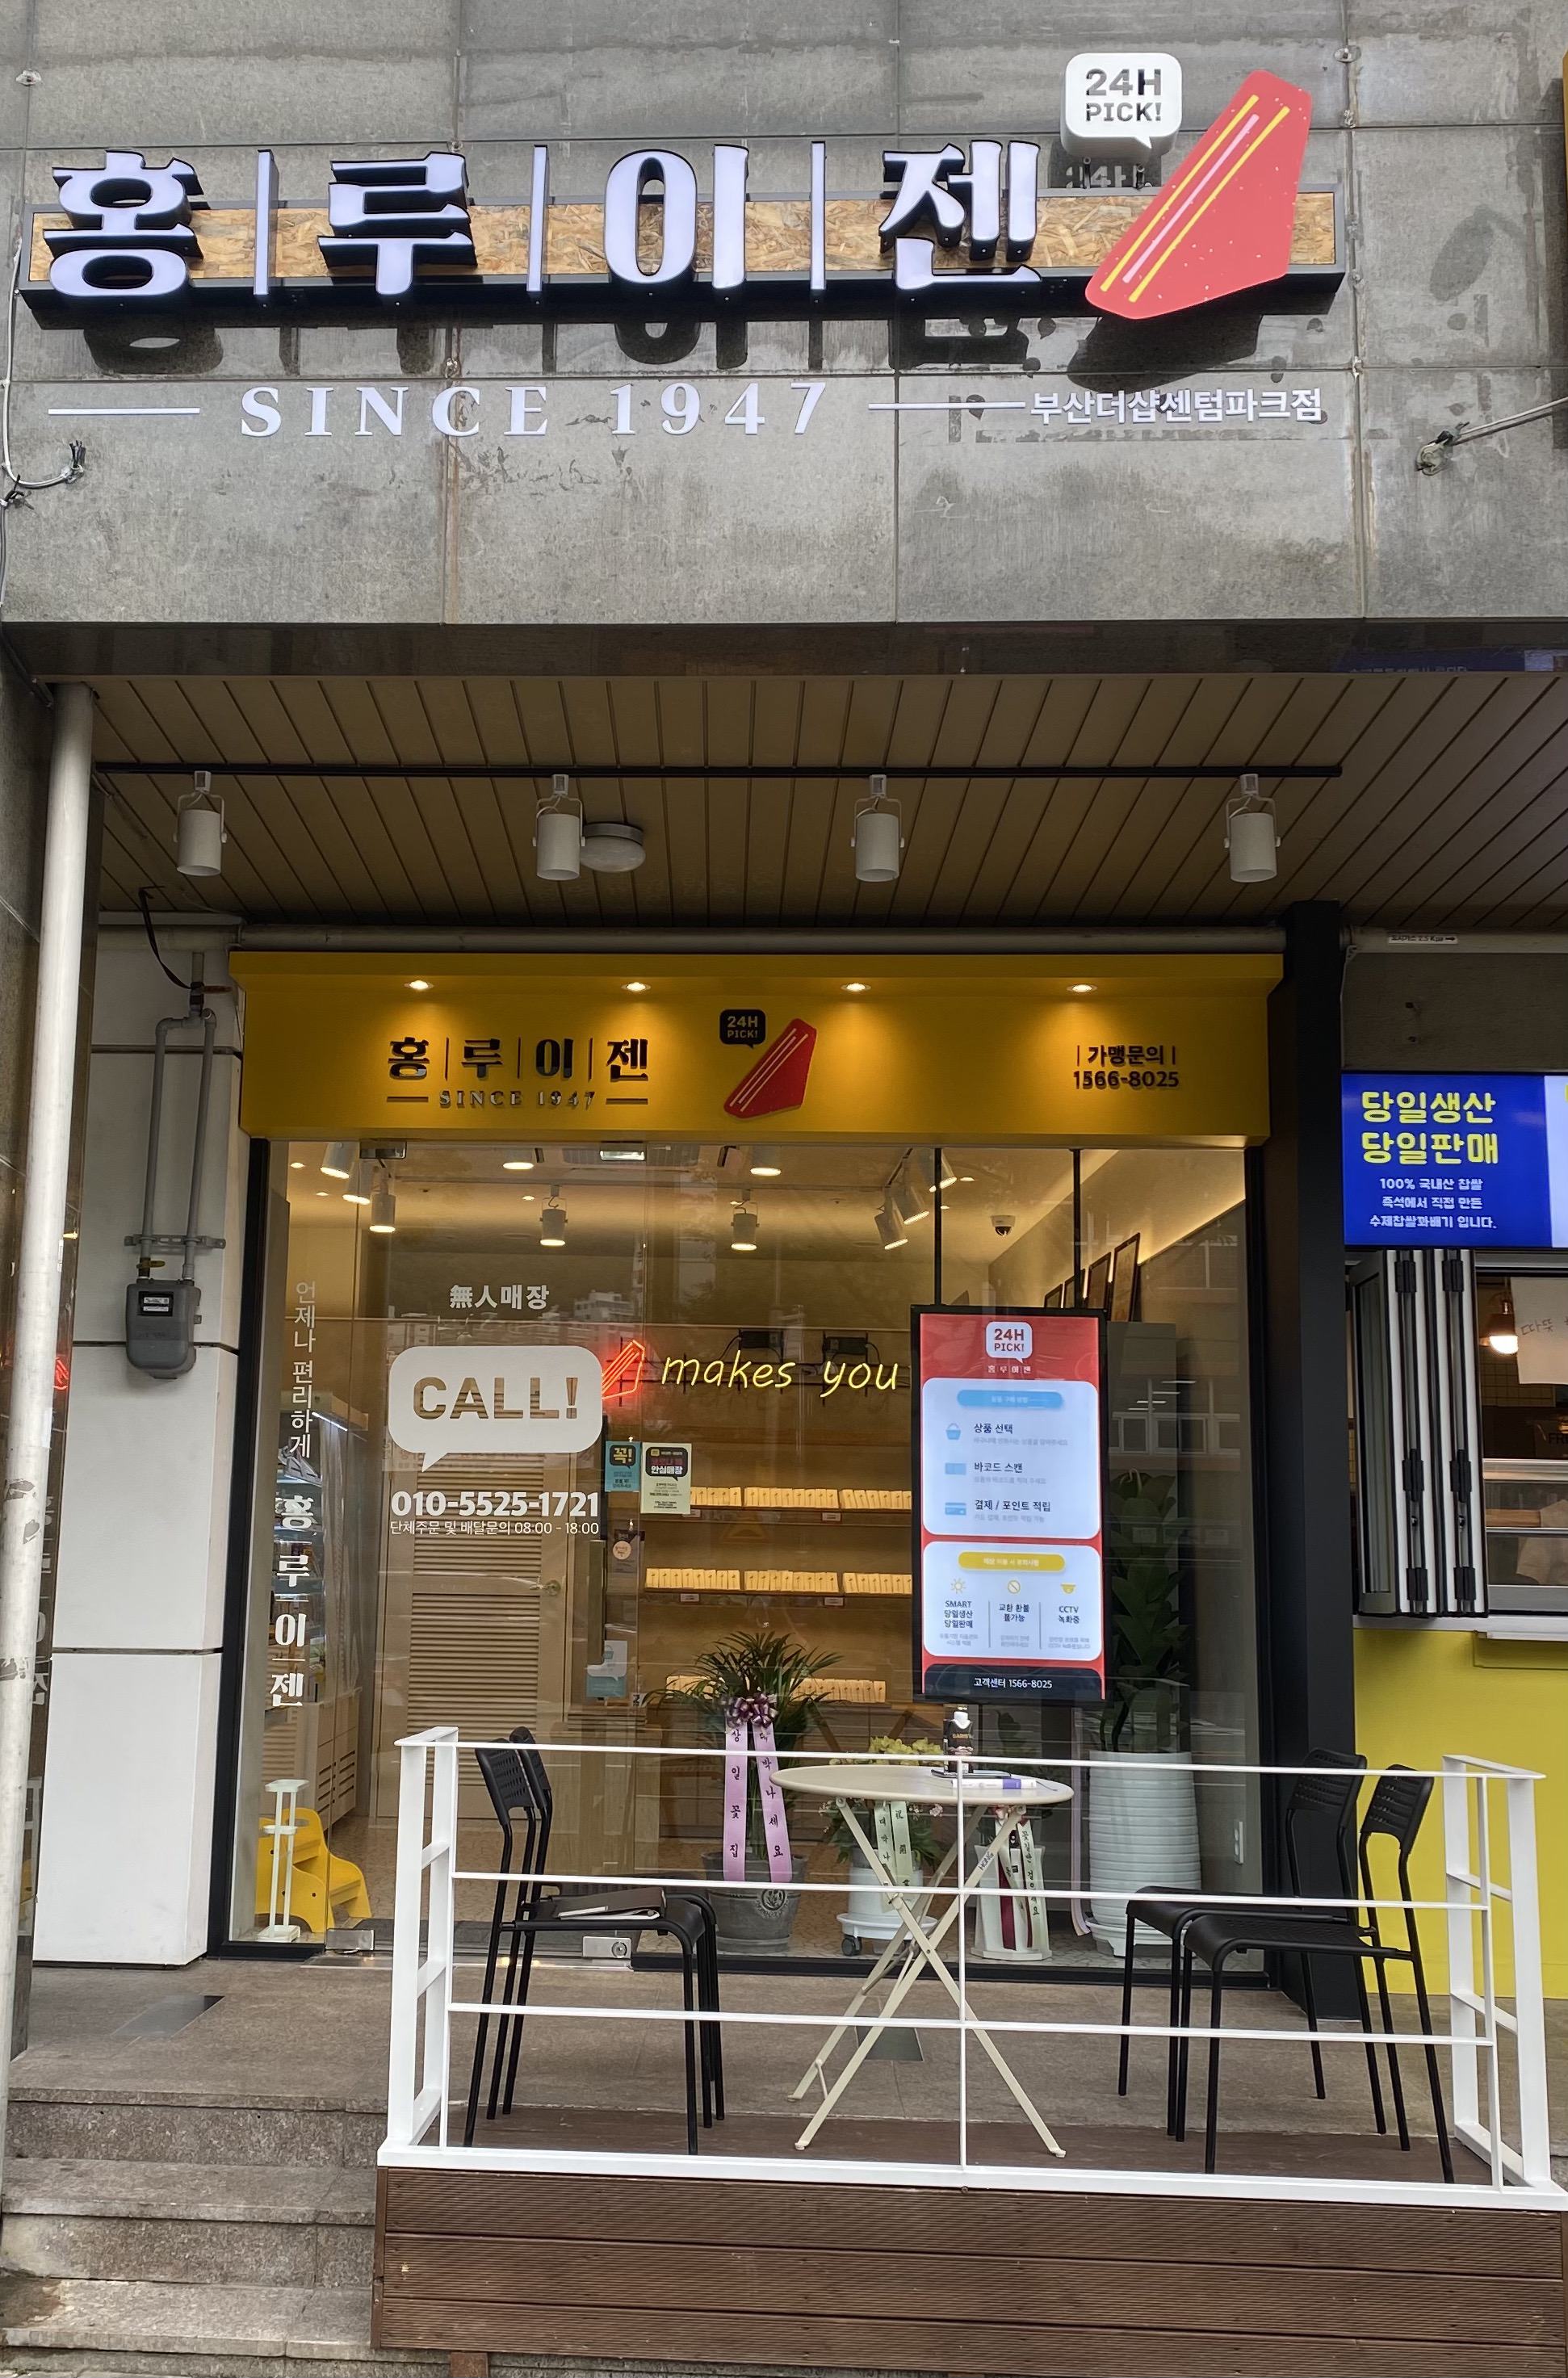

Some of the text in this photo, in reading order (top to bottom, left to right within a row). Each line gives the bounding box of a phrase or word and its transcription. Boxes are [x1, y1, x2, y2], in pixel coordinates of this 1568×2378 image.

[1084, 68, 1163, 96] 24H
[1084, 102, 1162, 123] PICK!
[241, 381, 826, 438] SINCE 1947
[1029, 387, 1323, 426] 부산더샵센텀파크점
[727, 1015, 758, 1029] 24H
[727, 1030, 758, 1038] PICK!
[1087, 1044, 1164, 1067] 가맹문의
[1073, 1070, 1180, 1090] 1566-8025
[438, 1089, 597, 1109] SINCE 1947
[1361, 1091, 1497, 1124] 당일생산
[1361, 1132, 1499, 1165] 당일판매
[1379, 1177, 1483, 1191] 100% 국내산 찹쌀
[1381, 1196, 1482, 1210] 즉석에서 직접 만든
[1457, 1215, 1497, 1229] 입니다.
[449, 1284, 550, 1310] 無人매장
[993, 1328, 1025, 1341] 24H
[993, 1343, 1025, 1352] PICK!
[290, 1281, 317, 1458] 언제나 편리하게
[661, 1349, 899, 1398] makes you
[413, 1376, 579, 1420] CALL!
[974, 1423, 1013, 1434] 상품 선택
[613, 1447, 633, 1464] 꼭!
[974, 1462, 1023, 1474] 바코드 스캔
[390, 1491, 599, 1517] 010-5525-1721
[975, 1499, 993, 1510] 결제
[1002, 1500, 1030, 1511] 포인트
[1033, 1501, 1051, 1512] 적립
[390, 1520, 440, 1534] 단체주문
[444, 1520, 457, 1534] 및
[460, 1520, 510, 1534] 배달문의
[514, 1521, 552, 1534] 08:00
[564, 1521, 599, 1534] 18:00
[945, 1600, 972, 1608] SMART
[999, 1604, 1012, 1613] 교환
[1059, 1605, 1080, 1613] CCTV
[973, 1677, 1053, 1688] 고객센터 1566-8025
